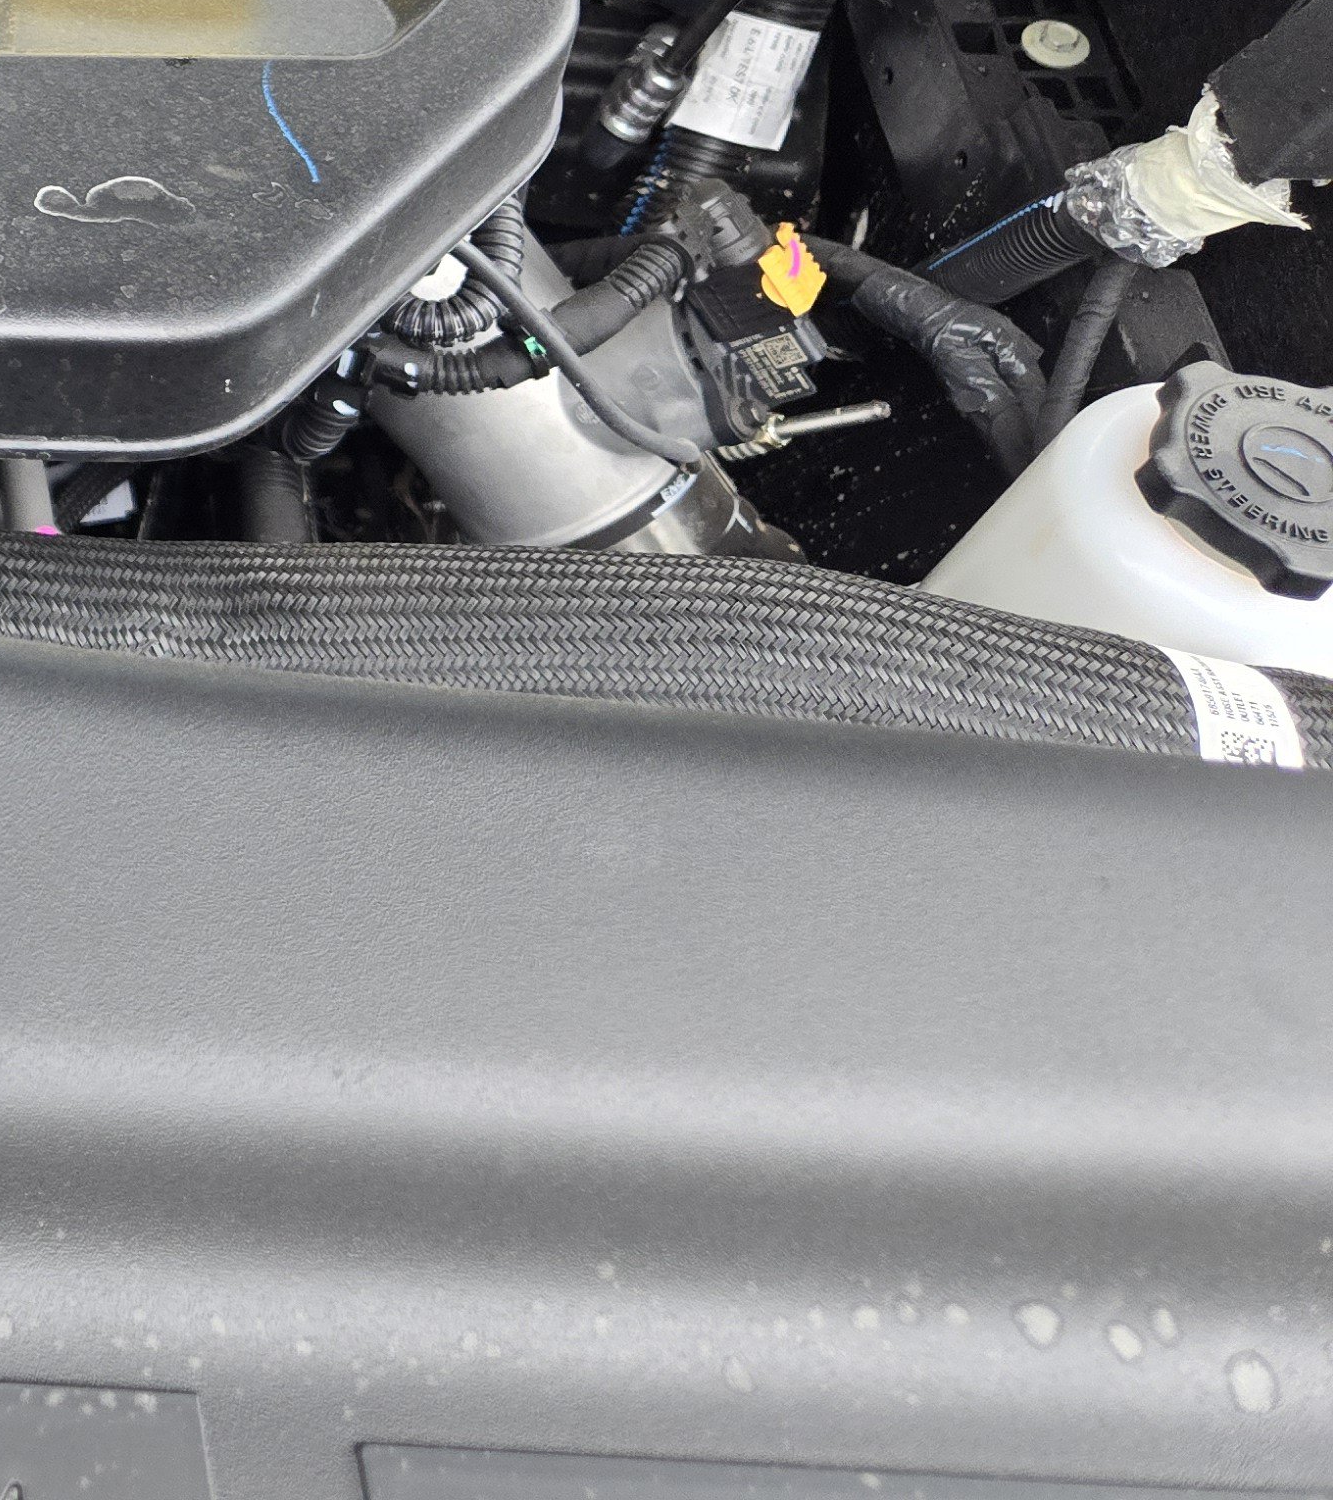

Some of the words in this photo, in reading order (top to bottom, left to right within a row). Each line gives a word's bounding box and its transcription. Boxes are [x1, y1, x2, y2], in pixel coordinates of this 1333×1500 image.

[1235, 385, 1287, 402] USE
[1189, 393, 1229, 460] POWER
[1203, 467, 1330, 542] STEERING
[1231, 692, 1250, 722] OUTLET
